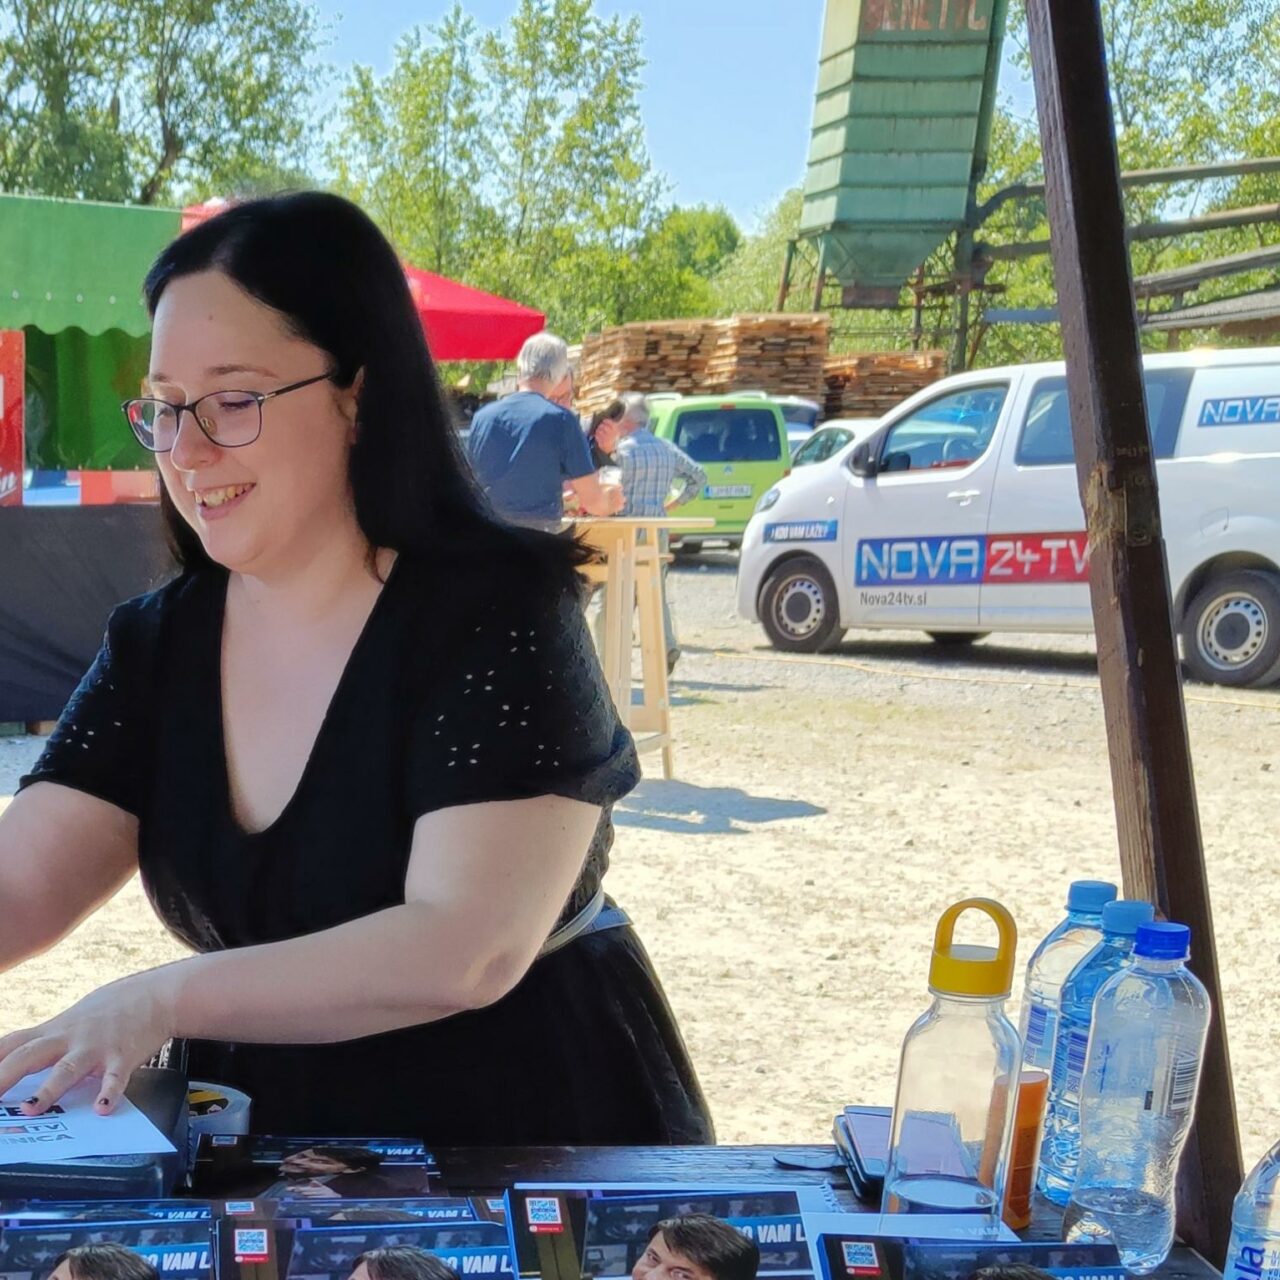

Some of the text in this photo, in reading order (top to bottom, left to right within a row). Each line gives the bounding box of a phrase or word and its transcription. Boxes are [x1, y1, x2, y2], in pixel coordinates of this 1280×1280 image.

[1202, 398, 1280, 424] NOVA
[861, 539, 1091, 581] NOVA 24TV
[860, 592, 927, 606] Nova24tv.si
[167, 1211, 199, 1219] VAM
[428, 1210, 459, 1219] VAM
[757, 1224, 792, 1244] VAM
[162, 1251, 197, 1271] VAM
[462, 1254, 497, 1274] VAM
